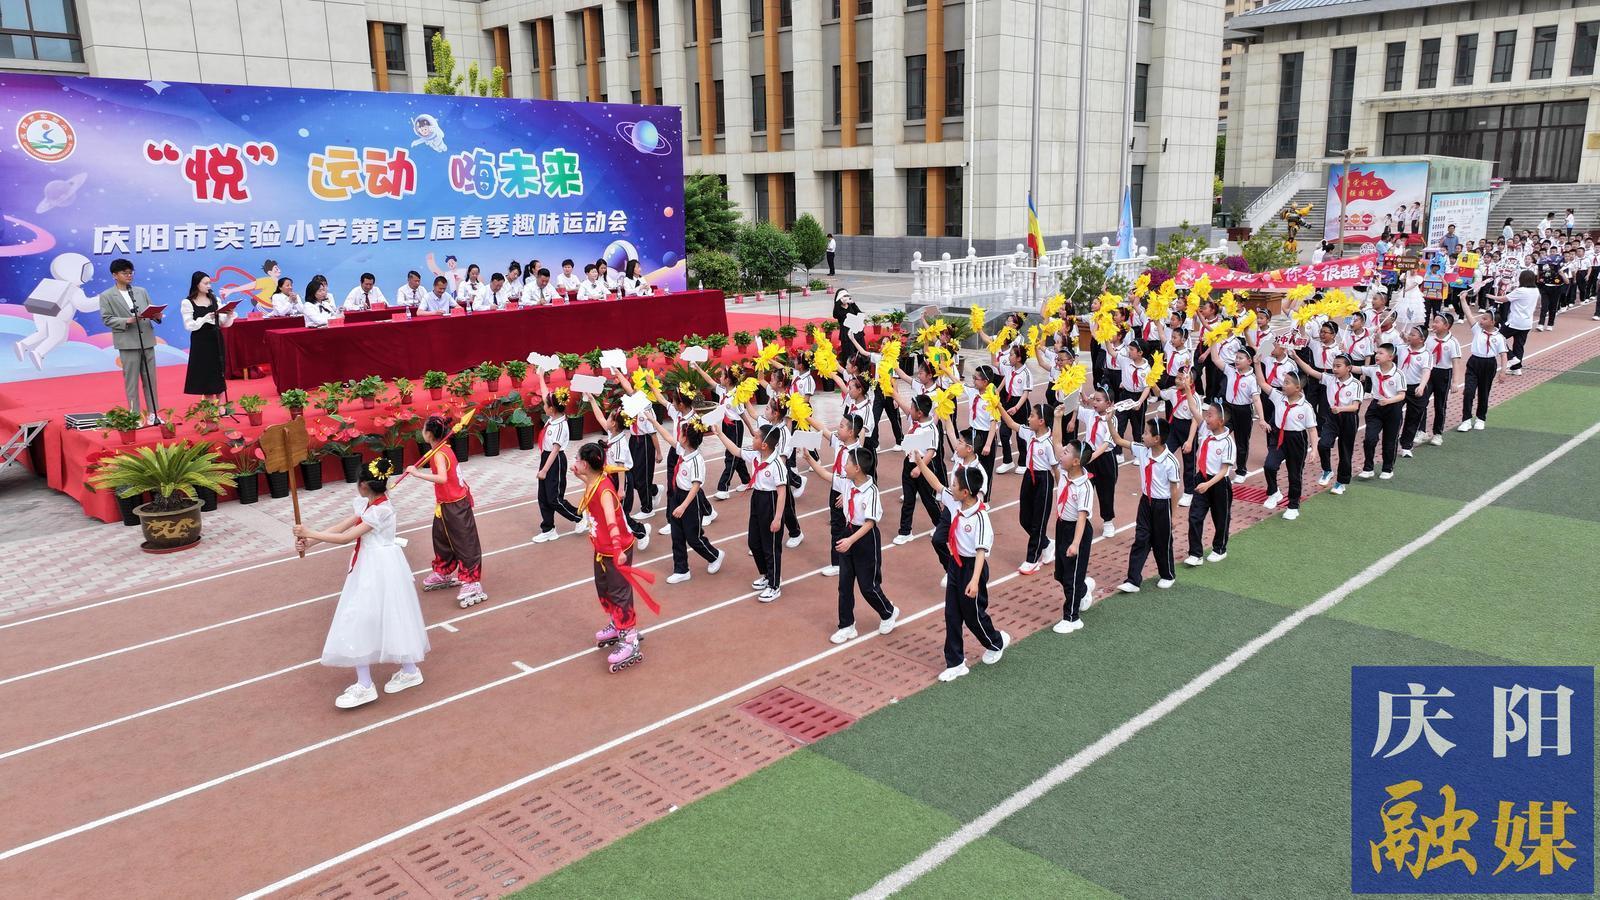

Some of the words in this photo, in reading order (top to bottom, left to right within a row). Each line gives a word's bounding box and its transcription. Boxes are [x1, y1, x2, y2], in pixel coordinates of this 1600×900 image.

[308, 146, 417, 201] 运动
[449, 147, 583, 198] 嗨未来
[93, 210, 628, 254] 庆阳市实验小学第25届春季趣味运动会
[1284, 264, 1360, 282] 你会很酷
